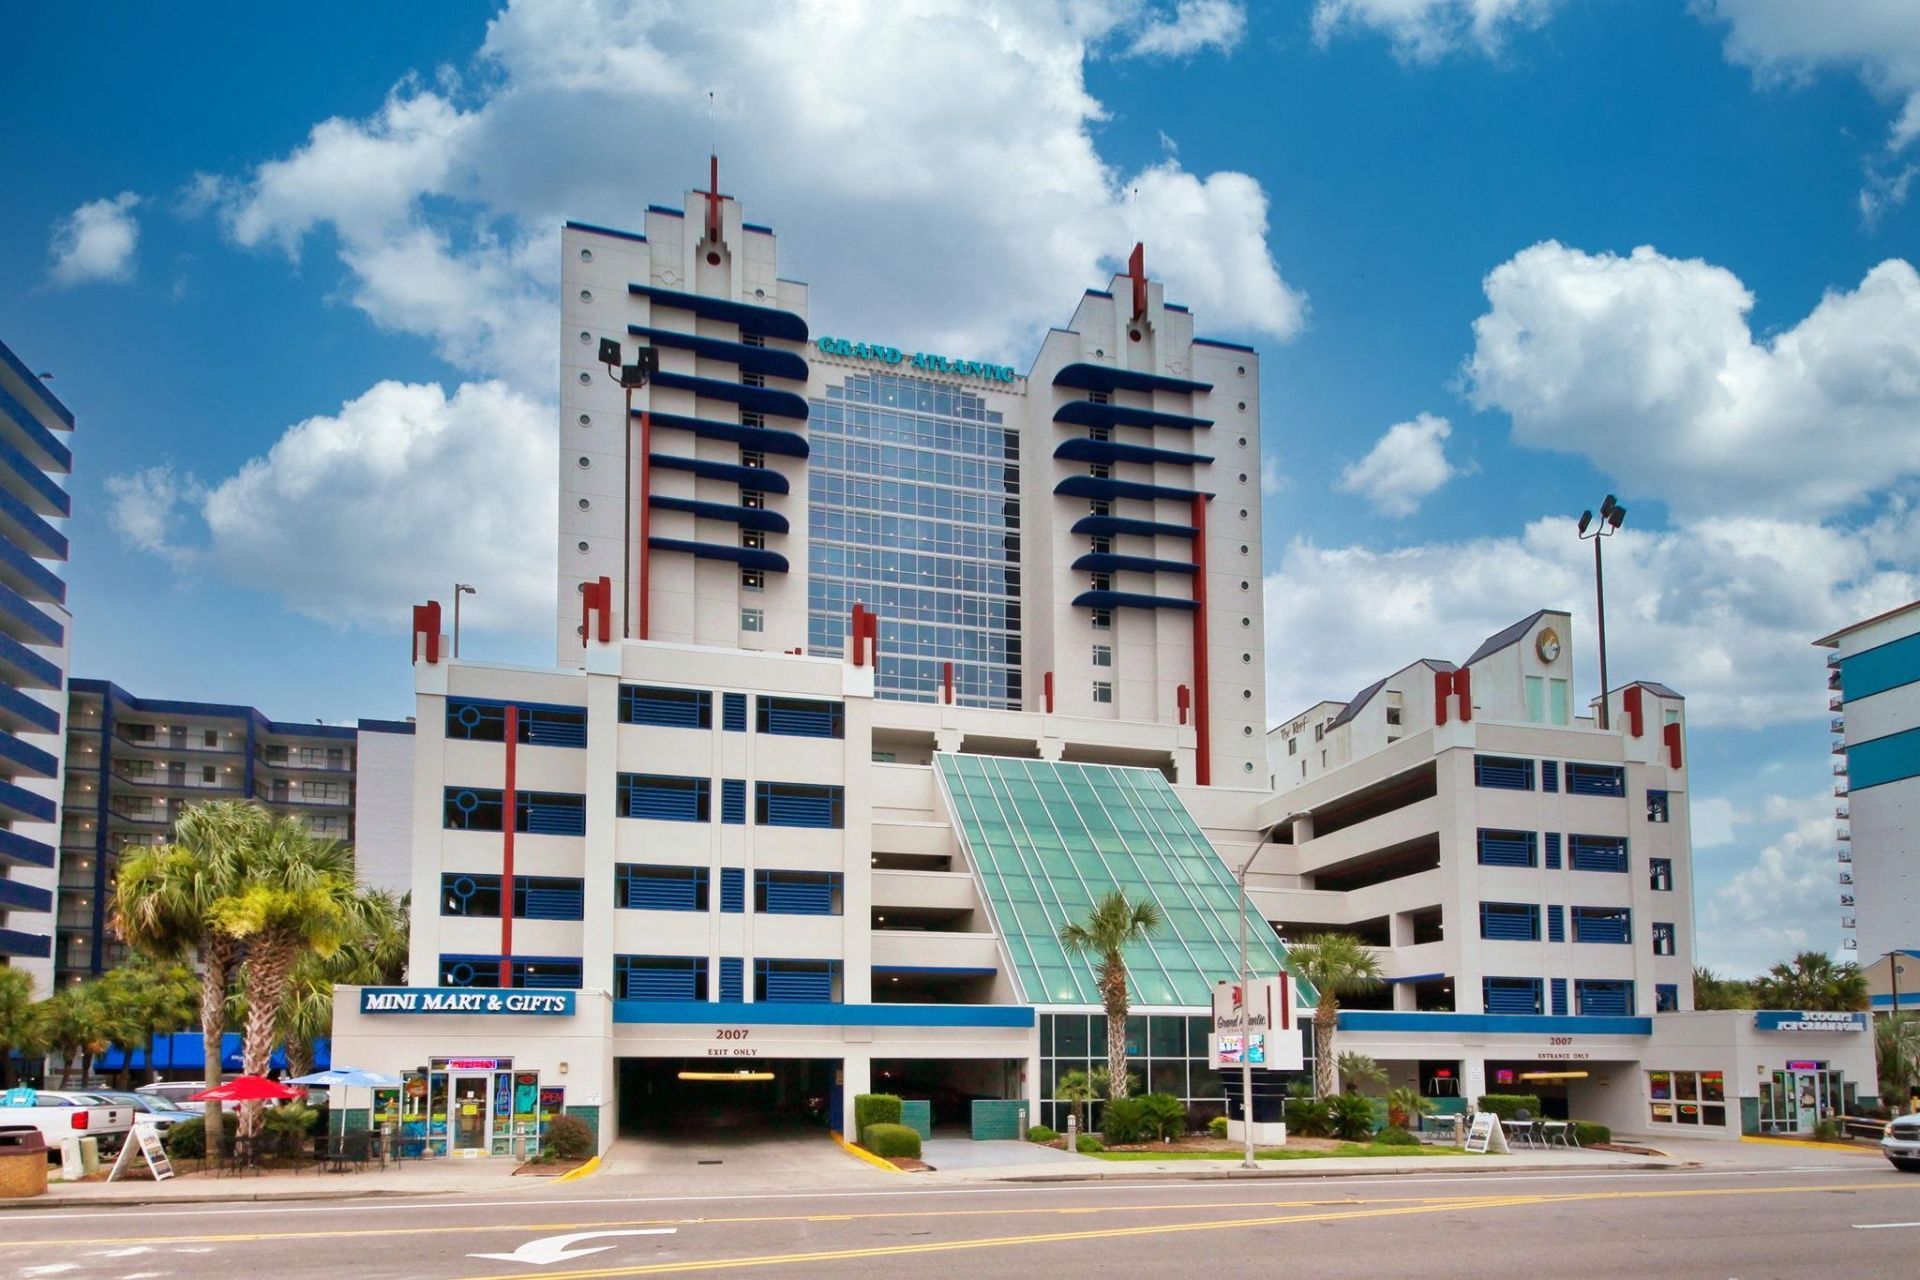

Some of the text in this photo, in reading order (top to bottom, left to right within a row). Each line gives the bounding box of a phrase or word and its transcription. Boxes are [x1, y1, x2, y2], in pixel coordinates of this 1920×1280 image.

[817, 336, 1015, 383] GRAND ATLANTIC
[366, 994, 565, 1011] MINI MART & GIFTS
[1217, 1016, 1239, 1028] Grand
[1777, 1021, 1798, 1031] ICE
[716, 1029, 749, 1040] 2007
[1550, 1037, 1572, 1045] 2007
[452, 1060, 494, 1069] OPEN
